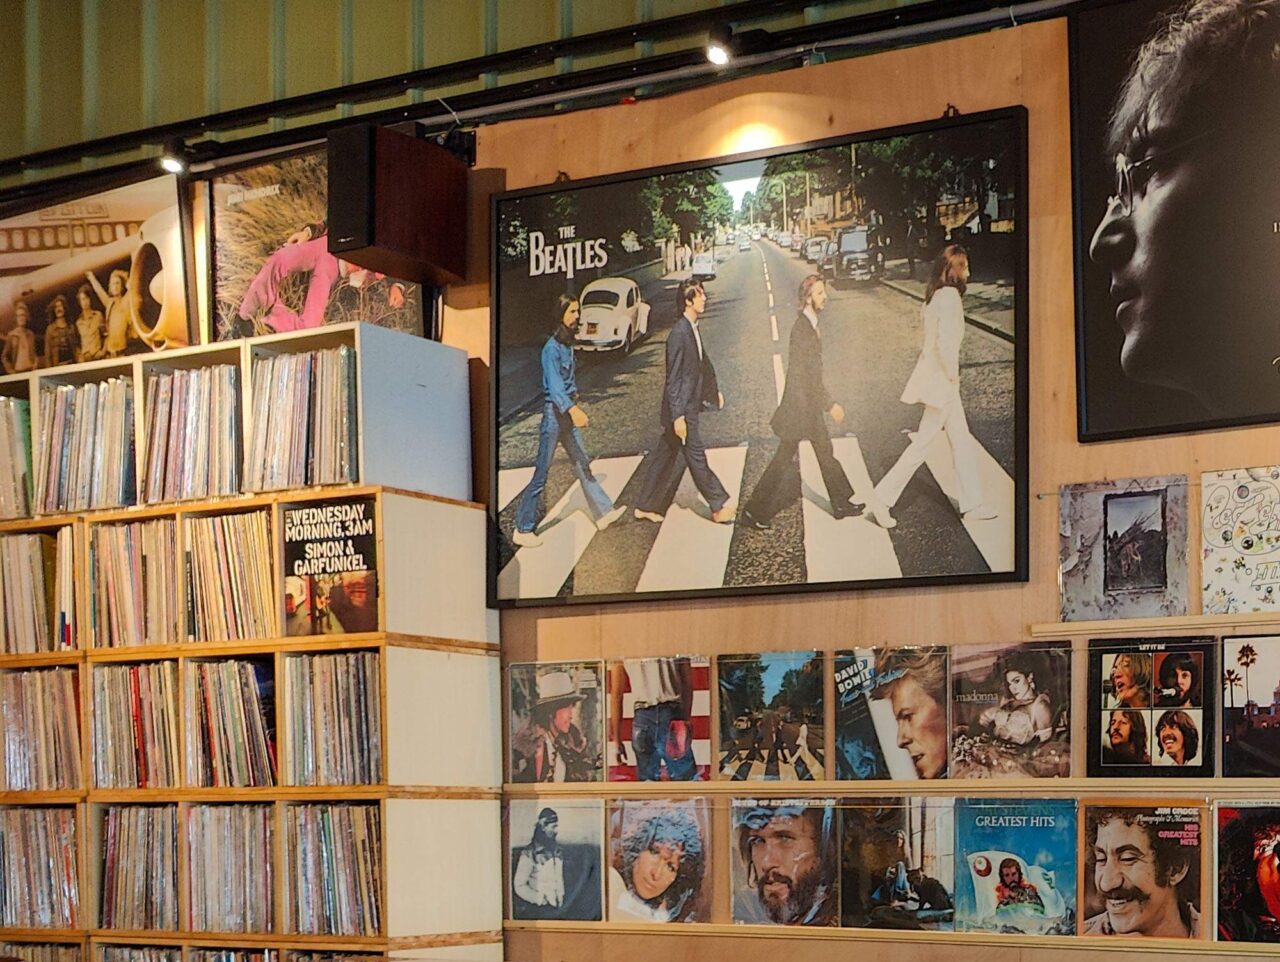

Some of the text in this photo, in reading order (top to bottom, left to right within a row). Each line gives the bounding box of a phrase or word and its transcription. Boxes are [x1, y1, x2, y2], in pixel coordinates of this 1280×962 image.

[558, 225, 576, 239] THE
[529, 231, 608, 279] BEATLES
[292, 503, 365, 526] WEDNESDAY
[305, 539, 355, 559] SIMON &
[294, 554, 368, 576] GARFUNKEL
[835, 660, 866, 683] DAVID
[838, 668, 874, 693] BOWIE
[956, 689, 998, 702] madonna
[1154, 807, 1171, 815] JIM
[975, 815, 1055, 827] GREATEST HITS
[1158, 830, 1199, 839] GREATEST
[1180, 838, 1199, 846] HITS
